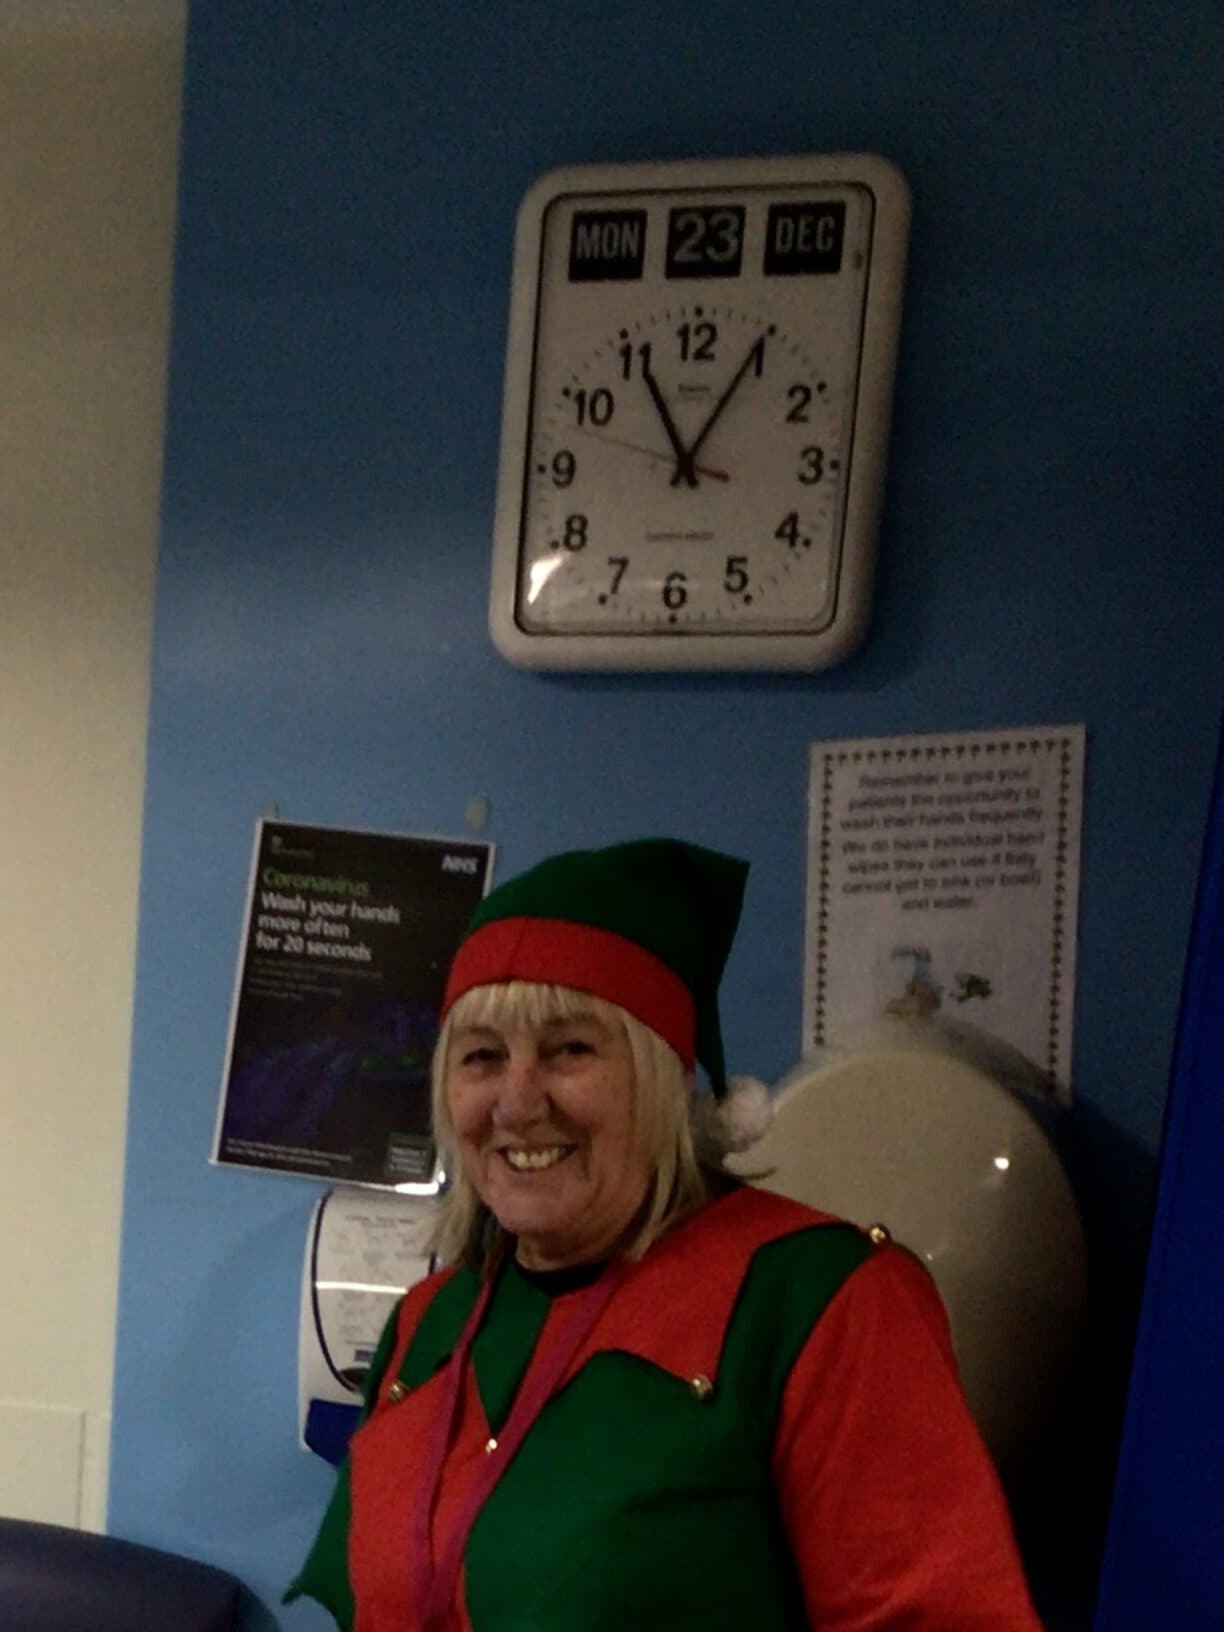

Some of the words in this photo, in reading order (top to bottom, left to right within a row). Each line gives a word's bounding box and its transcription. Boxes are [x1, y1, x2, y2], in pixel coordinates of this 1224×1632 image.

[575, 220, 641, 260] MON
[676, 212, 739, 262] 23
[777, 215, 836, 253] DEC
[619, 341, 652, 381] 11
[677, 322, 717, 363] 12
[752, 337, 765, 378] 1
[573, 388, 615, 427] 10
[786, 384, 811, 423] 2
[551, 450, 575, 488] 9
[798, 447, 824, 486] 3
[563, 513, 588, 552] 8
[775, 512, 800, 549] 4
[607, 557, 630, 595] 7
[662, 572, 687, 610] 6
[725, 556, 749, 594] 5
[263, 867, 370, 898] Coronavirus
[441, 854, 478, 876] NHS
[261, 890, 306, 914] Wash
[310, 900, 347, 918] your
[350, 901, 401, 924] hands
[258, 914, 301, 932] more
[304, 916, 350, 939] often
[256, 930, 281, 951] for
[283, 933, 304, 954] 20
[307, 941, 372, 962] seconds
